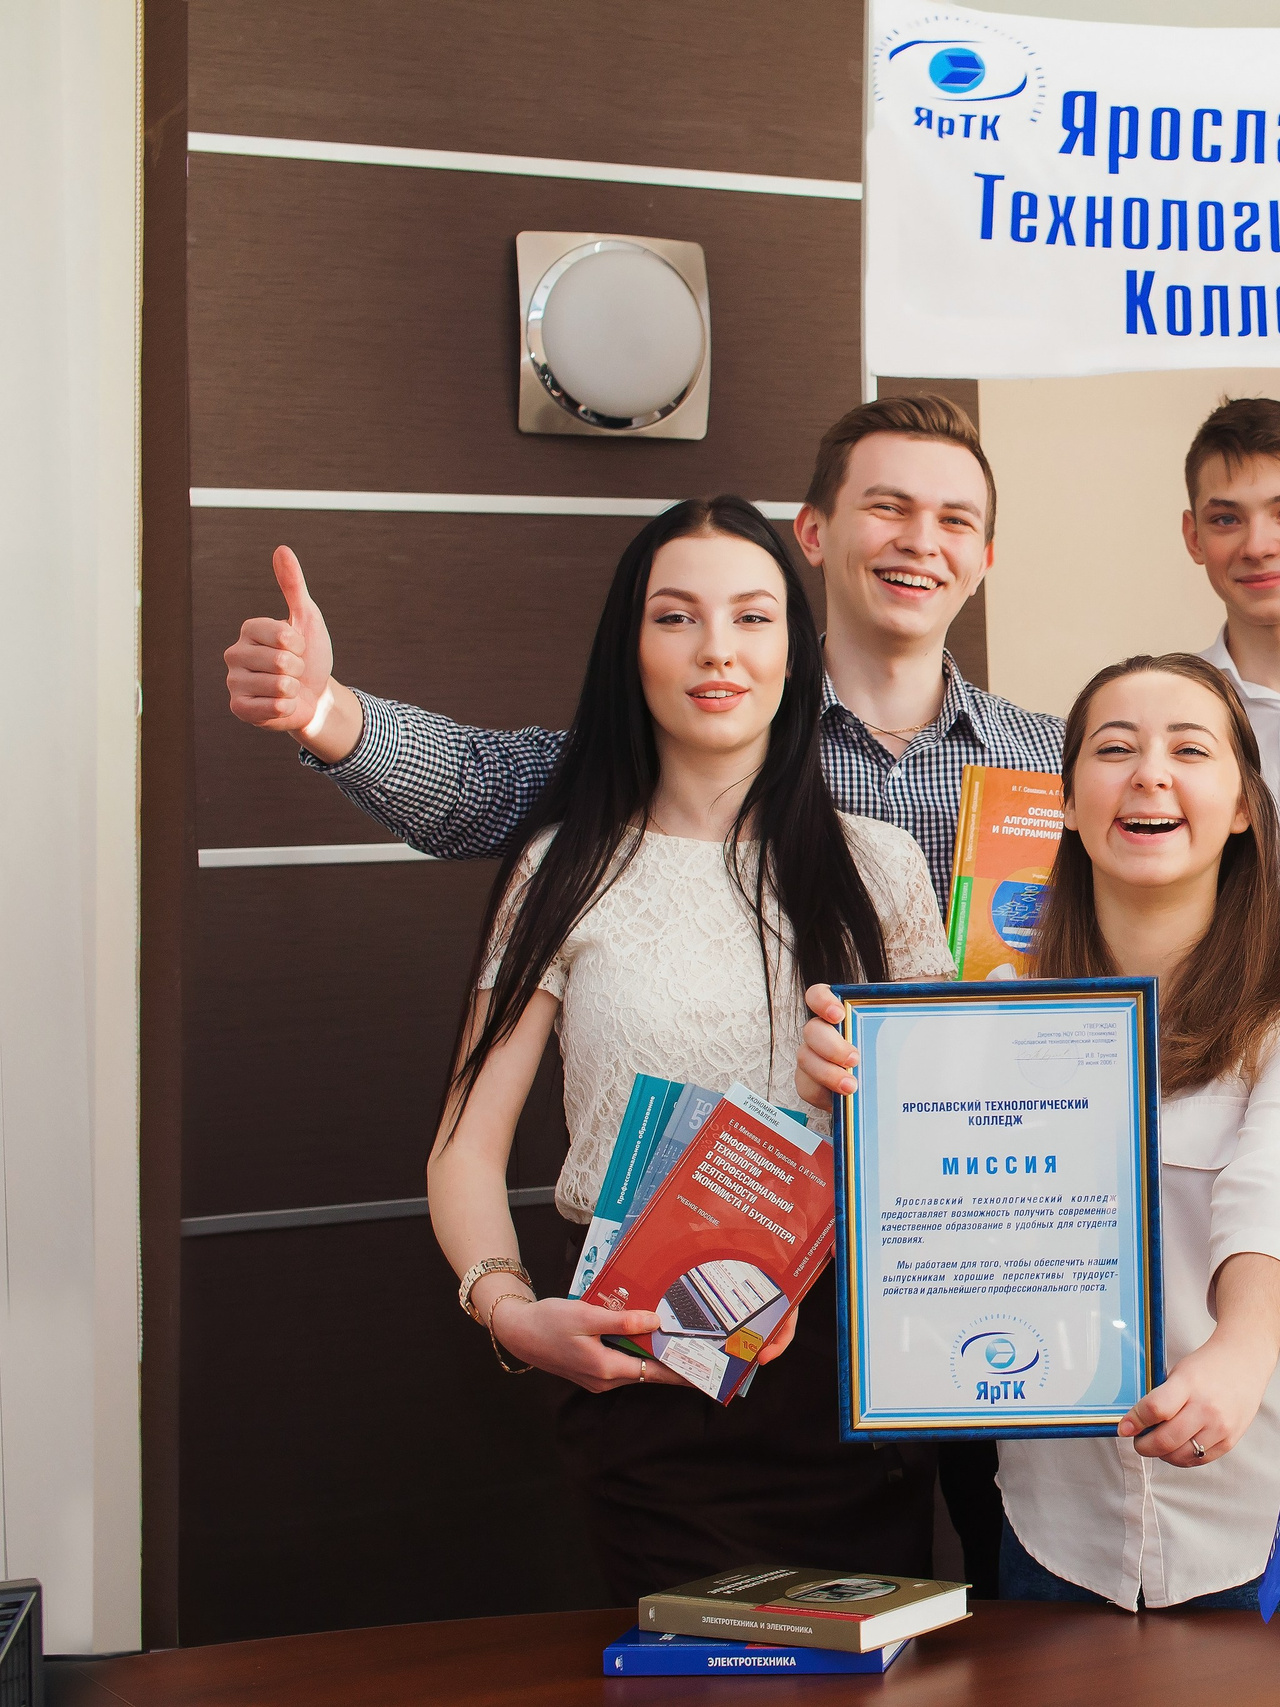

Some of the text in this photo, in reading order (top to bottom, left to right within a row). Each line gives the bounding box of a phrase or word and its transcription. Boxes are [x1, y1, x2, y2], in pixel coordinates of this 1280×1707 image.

[913, 106, 1001, 142] ЯрТК
[992, 825, 1000, 833] И
[747, 1095, 778, 1117] ЭКОНОМИКА
[902, 1097, 1089, 1113] ЯРОСЛАВСКИЙ ТЕХНОЛОГИЧЕСКИЙ
[748, 1104, 781, 1127] УПРАВЛЕНИЕ
[968, 1114, 1023, 1127] КОЛЛЕДЖ
[713, 1140, 763, 1178] ТЕХНОЛОГИИ
[719, 1131, 795, 1186] ИНФОРМАЦИОННЫЕ
[942, 1155, 1057, 1176] МИССИЯ
[697, 1161, 758, 1205] ДЕЯТЕЛЬНОСТИ
[705, 1151, 795, 1214] В ПРОФЕССИОНАЛЬНОЙ
[676, 1194, 699, 1211] УЧЕБНОЕ
[692, 1170, 796, 1245] ЭКОНОМИСТА И БУХГАЛТЕРА
[895, 1194, 1117, 1208] Ярославский технологический колледж
[881, 1207, 1117, 1220] предоставляет возможность получить современное
[881, 1223, 942, 1231] качественное
[946, 1221, 1003, 1232] образование
[1015, 1220, 1054, 1231] удобных
[1057, 1221, 1074, 1229] для
[1077, 1219, 1117, 1230] студента
[807, 1217, 835, 1257] ПРОФЕССИОНАЛЬ
[882, 1236, 925, 1246] условиях.
[897, 1260, 912, 1269] Мы
[915, 1260, 958, 1270] работаем
[960, 1261, 977, 1269] для
[1004, 1258, 1031, 1267] чтобы
[1034, 1258, 1085, 1268] обеспечить
[1088, 1258, 1118, 1266] нашим
[882, 1271, 1118, 1284] выпускникам хорошие перспективы трудоуст-
[883, 1286, 918, 1296] ройства
[926, 1286, 987, 1295] дальнейшего
[988, 1284, 1078, 1295] профессионального
[1080, 1284, 1107, 1293] роста.
[976, 1380, 1026, 1404] ЯрТК
[702, 1616, 813, 1634] ЭЛЕКТРОТЕХНИКА И ЭЛЕКТРОНИКА
[707, 1657, 797, 1667] ЭЛЕКТРОТЕХНИКА
